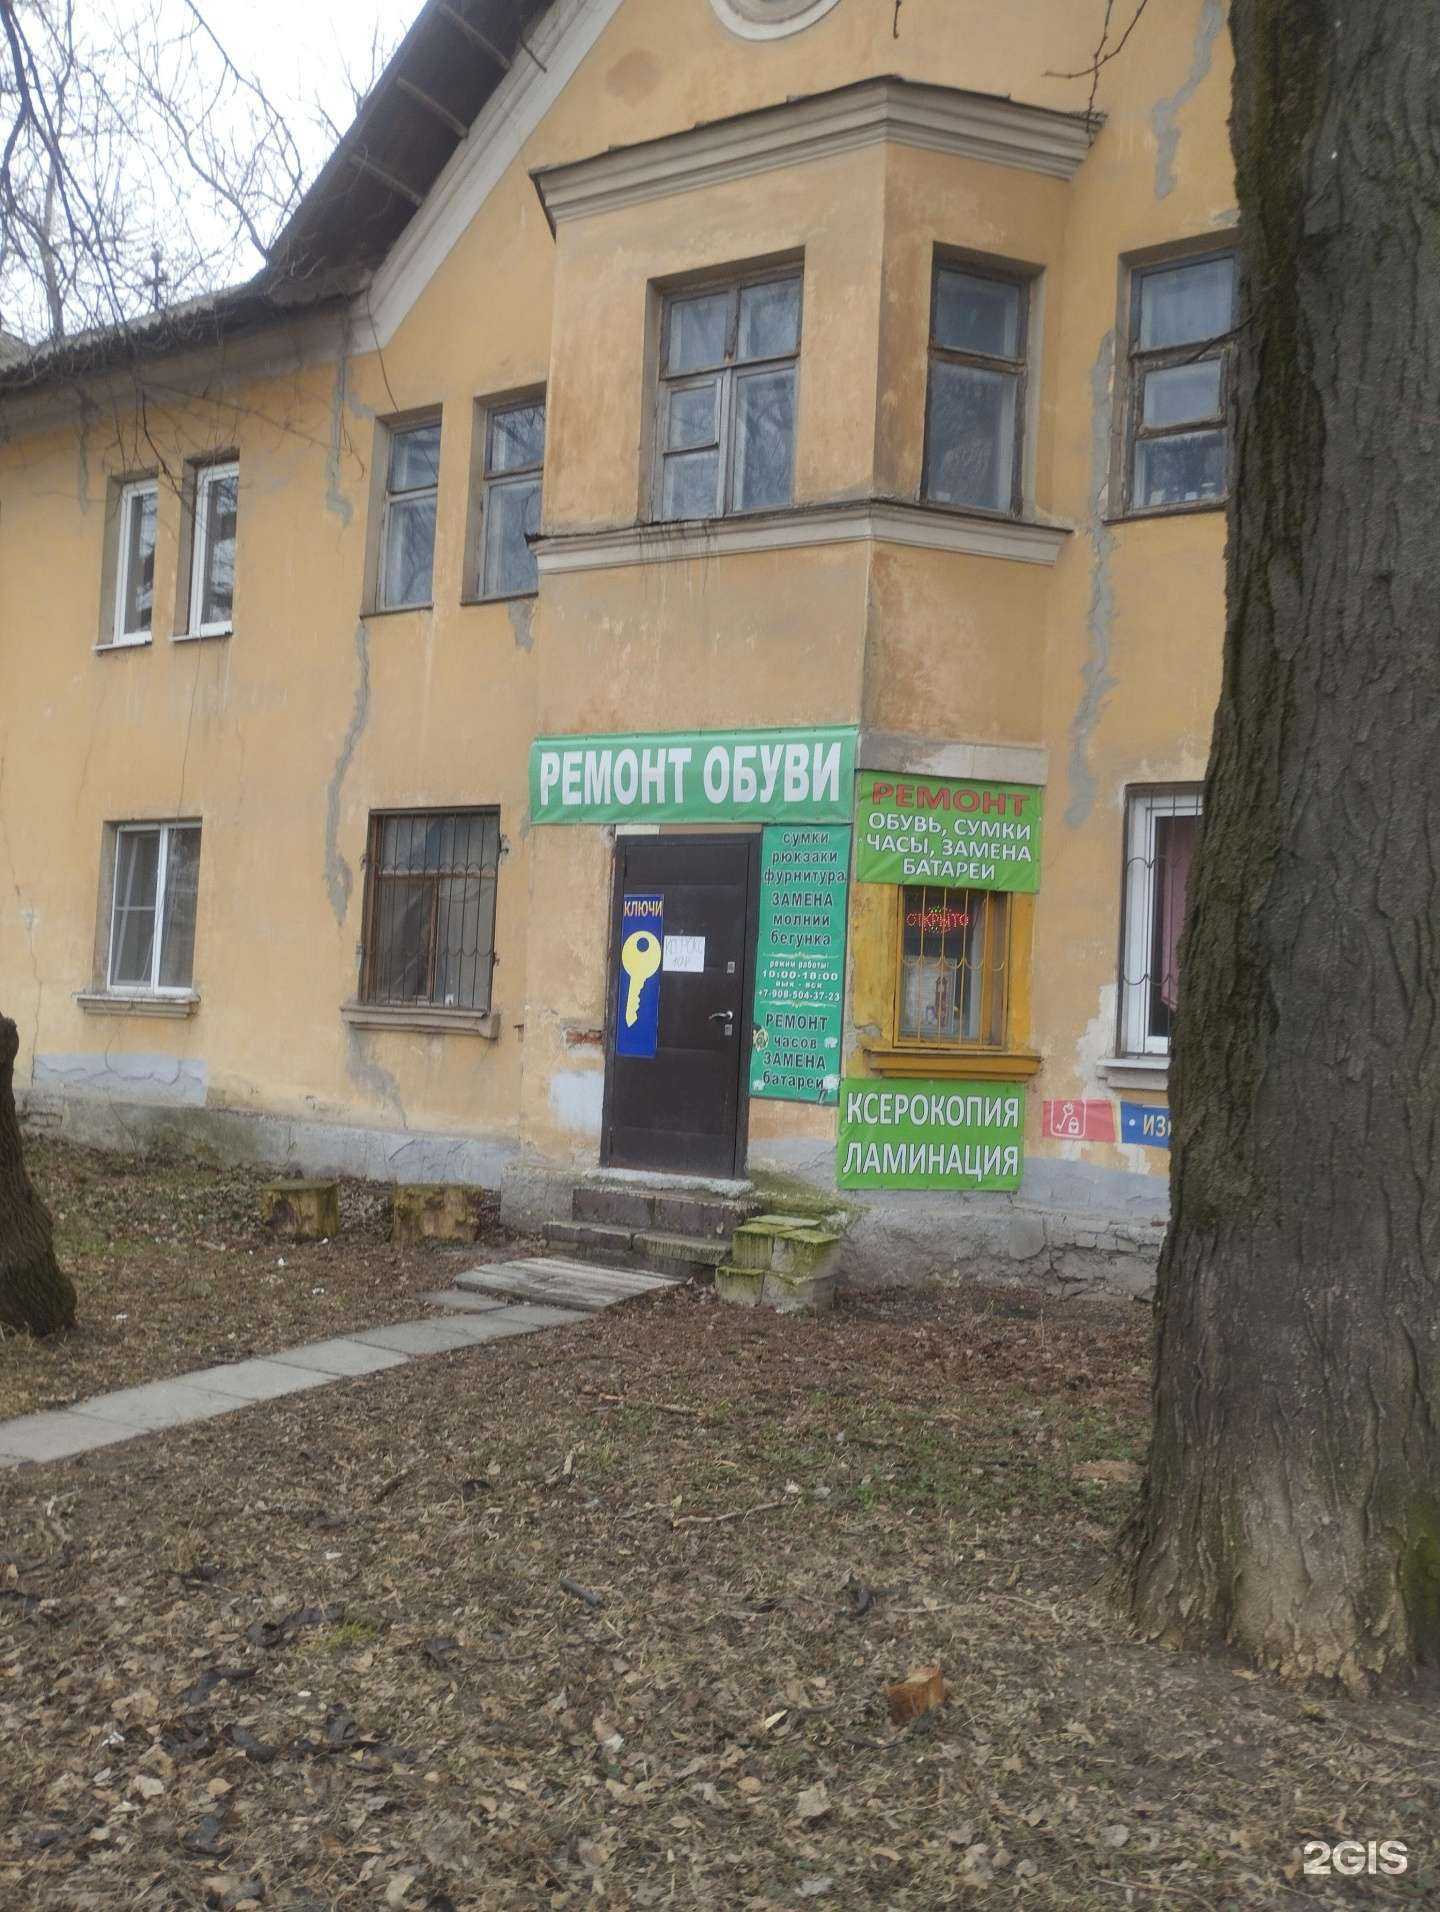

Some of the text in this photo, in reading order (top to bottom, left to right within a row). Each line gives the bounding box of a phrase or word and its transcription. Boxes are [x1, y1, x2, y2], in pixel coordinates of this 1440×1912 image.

[540, 742, 842, 806] РЕМОНТ ОБУВИ
[872, 782, 1030, 816] РЕМОНТ
[868, 812, 1031, 840] ОБУВЬ, СУМКИ
[783, 831, 829, 847] сумки
[866, 834, 1032, 862] ЧАСЫ, ЗАМЕНА
[772, 850, 837, 865] рюкзаки
[764, 868, 845, 885] фурнитура
[903, 858, 995, 880] БАТАРЕИ
[624, 901, 662, 917] КЛЮЧИ
[772, 892, 833, 907] ЗАМЕНА
[906, 913, 969, 927] ОТКРЫТО
[771, 929, 831, 948] бегунка
[765, 1012, 828, 1031] РЕМОНТ
[773, 1035, 817, 1049] часов
[763, 1051, 826, 1070] ЗАМЕНА
[846, 1092, 1019, 1128] КСЕРОКОПИЯ
[1143, 1114, 1171, 1137] ИЗ
[843, 1142, 1019, 1182] ЛАМИНАЦИЯ
